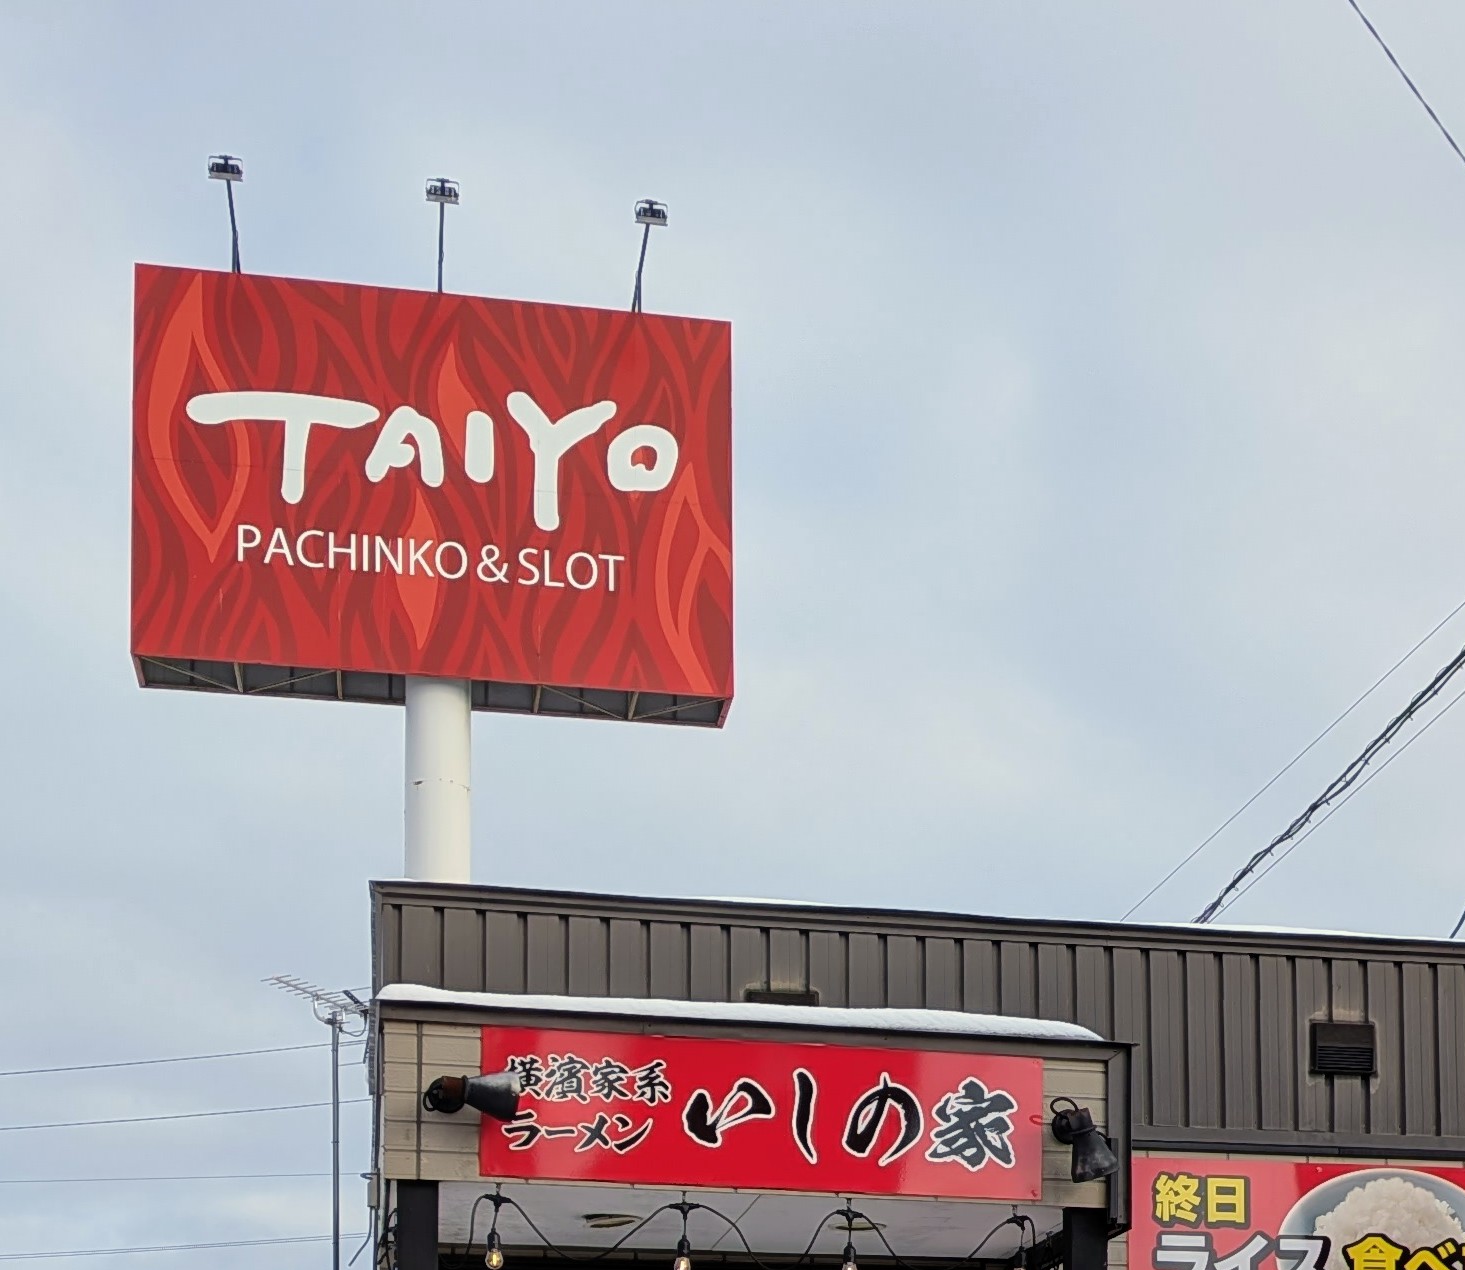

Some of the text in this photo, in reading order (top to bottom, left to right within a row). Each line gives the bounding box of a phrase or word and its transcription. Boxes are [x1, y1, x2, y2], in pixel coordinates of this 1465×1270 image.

[186, 391, 678, 531] TAIYO
[236, 523, 625, 592] PACHINKO & SLOT
[504, 1053, 671, 1106] 横濱家系
[502, 1109, 653, 1154] ラーメン
[683, 1067, 1018, 1171] いしの家
[1153, 1171, 1248, 1225] 終日
